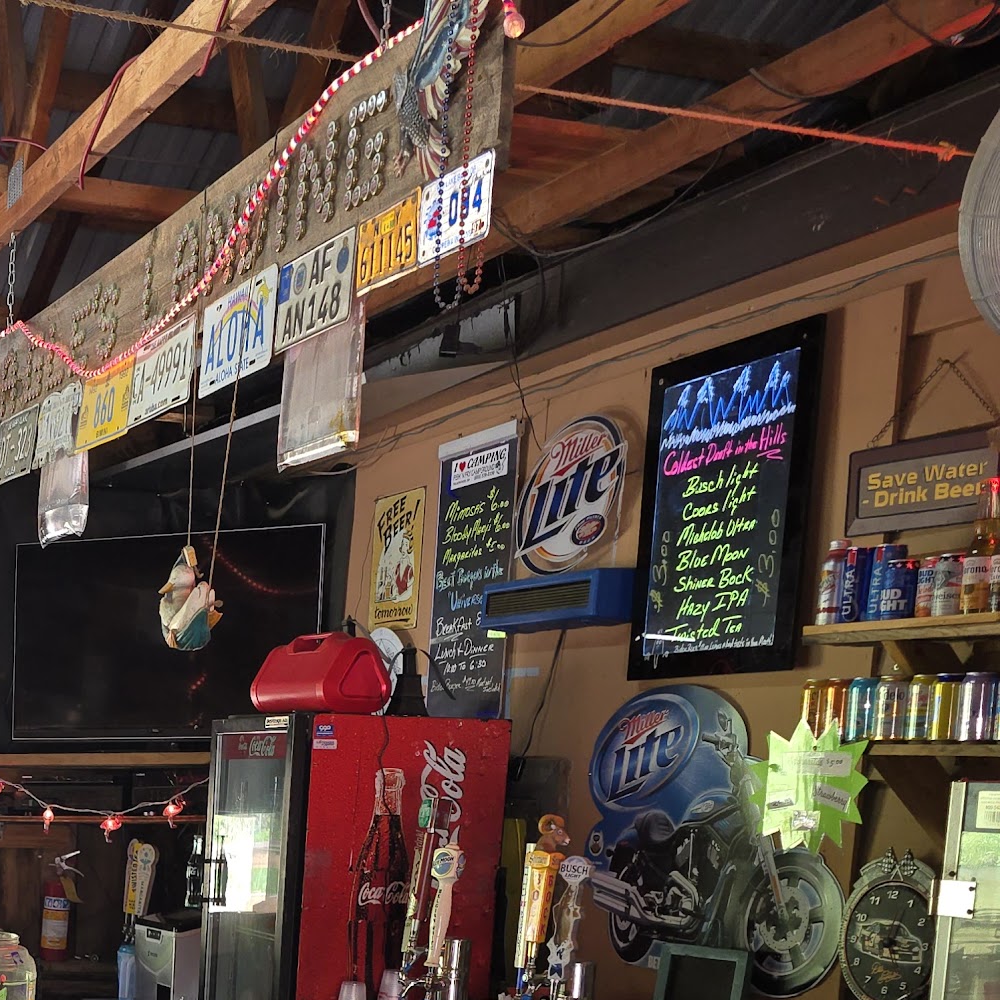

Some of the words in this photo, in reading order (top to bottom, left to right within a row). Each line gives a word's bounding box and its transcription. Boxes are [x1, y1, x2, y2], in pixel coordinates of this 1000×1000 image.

[360, 221, 413, 284] 611145
[308, 244, 335, 290] AF
[205, 297, 265, 375] ALOHA
[214, 366, 233, 384] ALOHA
[234, 356, 250, 376] STATE
[93, 386, 115, 429] 860
[467, 448, 507, 469] CAMPING
[551, 432, 607, 471] Miller
[664, 449, 706, 476] Coldest
[759, 423, 787, 450] Hills
[682, 470, 723, 497] Busch
[867, 471, 918, 490] Save
[924, 460, 989, 482] Water
[519, 450, 620, 550] Lite
[874, 487, 928, 508] Drink
[377, 496, 407, 542] FREE
[383, 499, 420, 555] BEER!
[442, 524, 472, 545] Bloody
[711, 588, 749, 611] IPA
[842, 568, 855, 615] ULTRA
[868, 566, 882, 613] ULTRA
[375, 604, 412, 619] tomorrow
[619, 708, 670, 738] Miller
[606, 725, 684, 804] Lite
[560, 863, 589, 875] BUSCH
[358, 882, 384, 906] Coca
[870, 896, 880, 905] 11
[887, 890, 899, 899] 12
[907, 899, 914, 908] 1
[855, 913, 867, 922] 10
[918, 918, 926, 927] 2
[850, 935, 857, 943] 9
[922, 943, 929, 951] 3
[853, 957, 860, 966] 8
[914, 967, 921, 975] 4
[864, 975, 872, 984] 7
[881, 986, 888, 994] 6
[899, 982, 907, 991] 5
